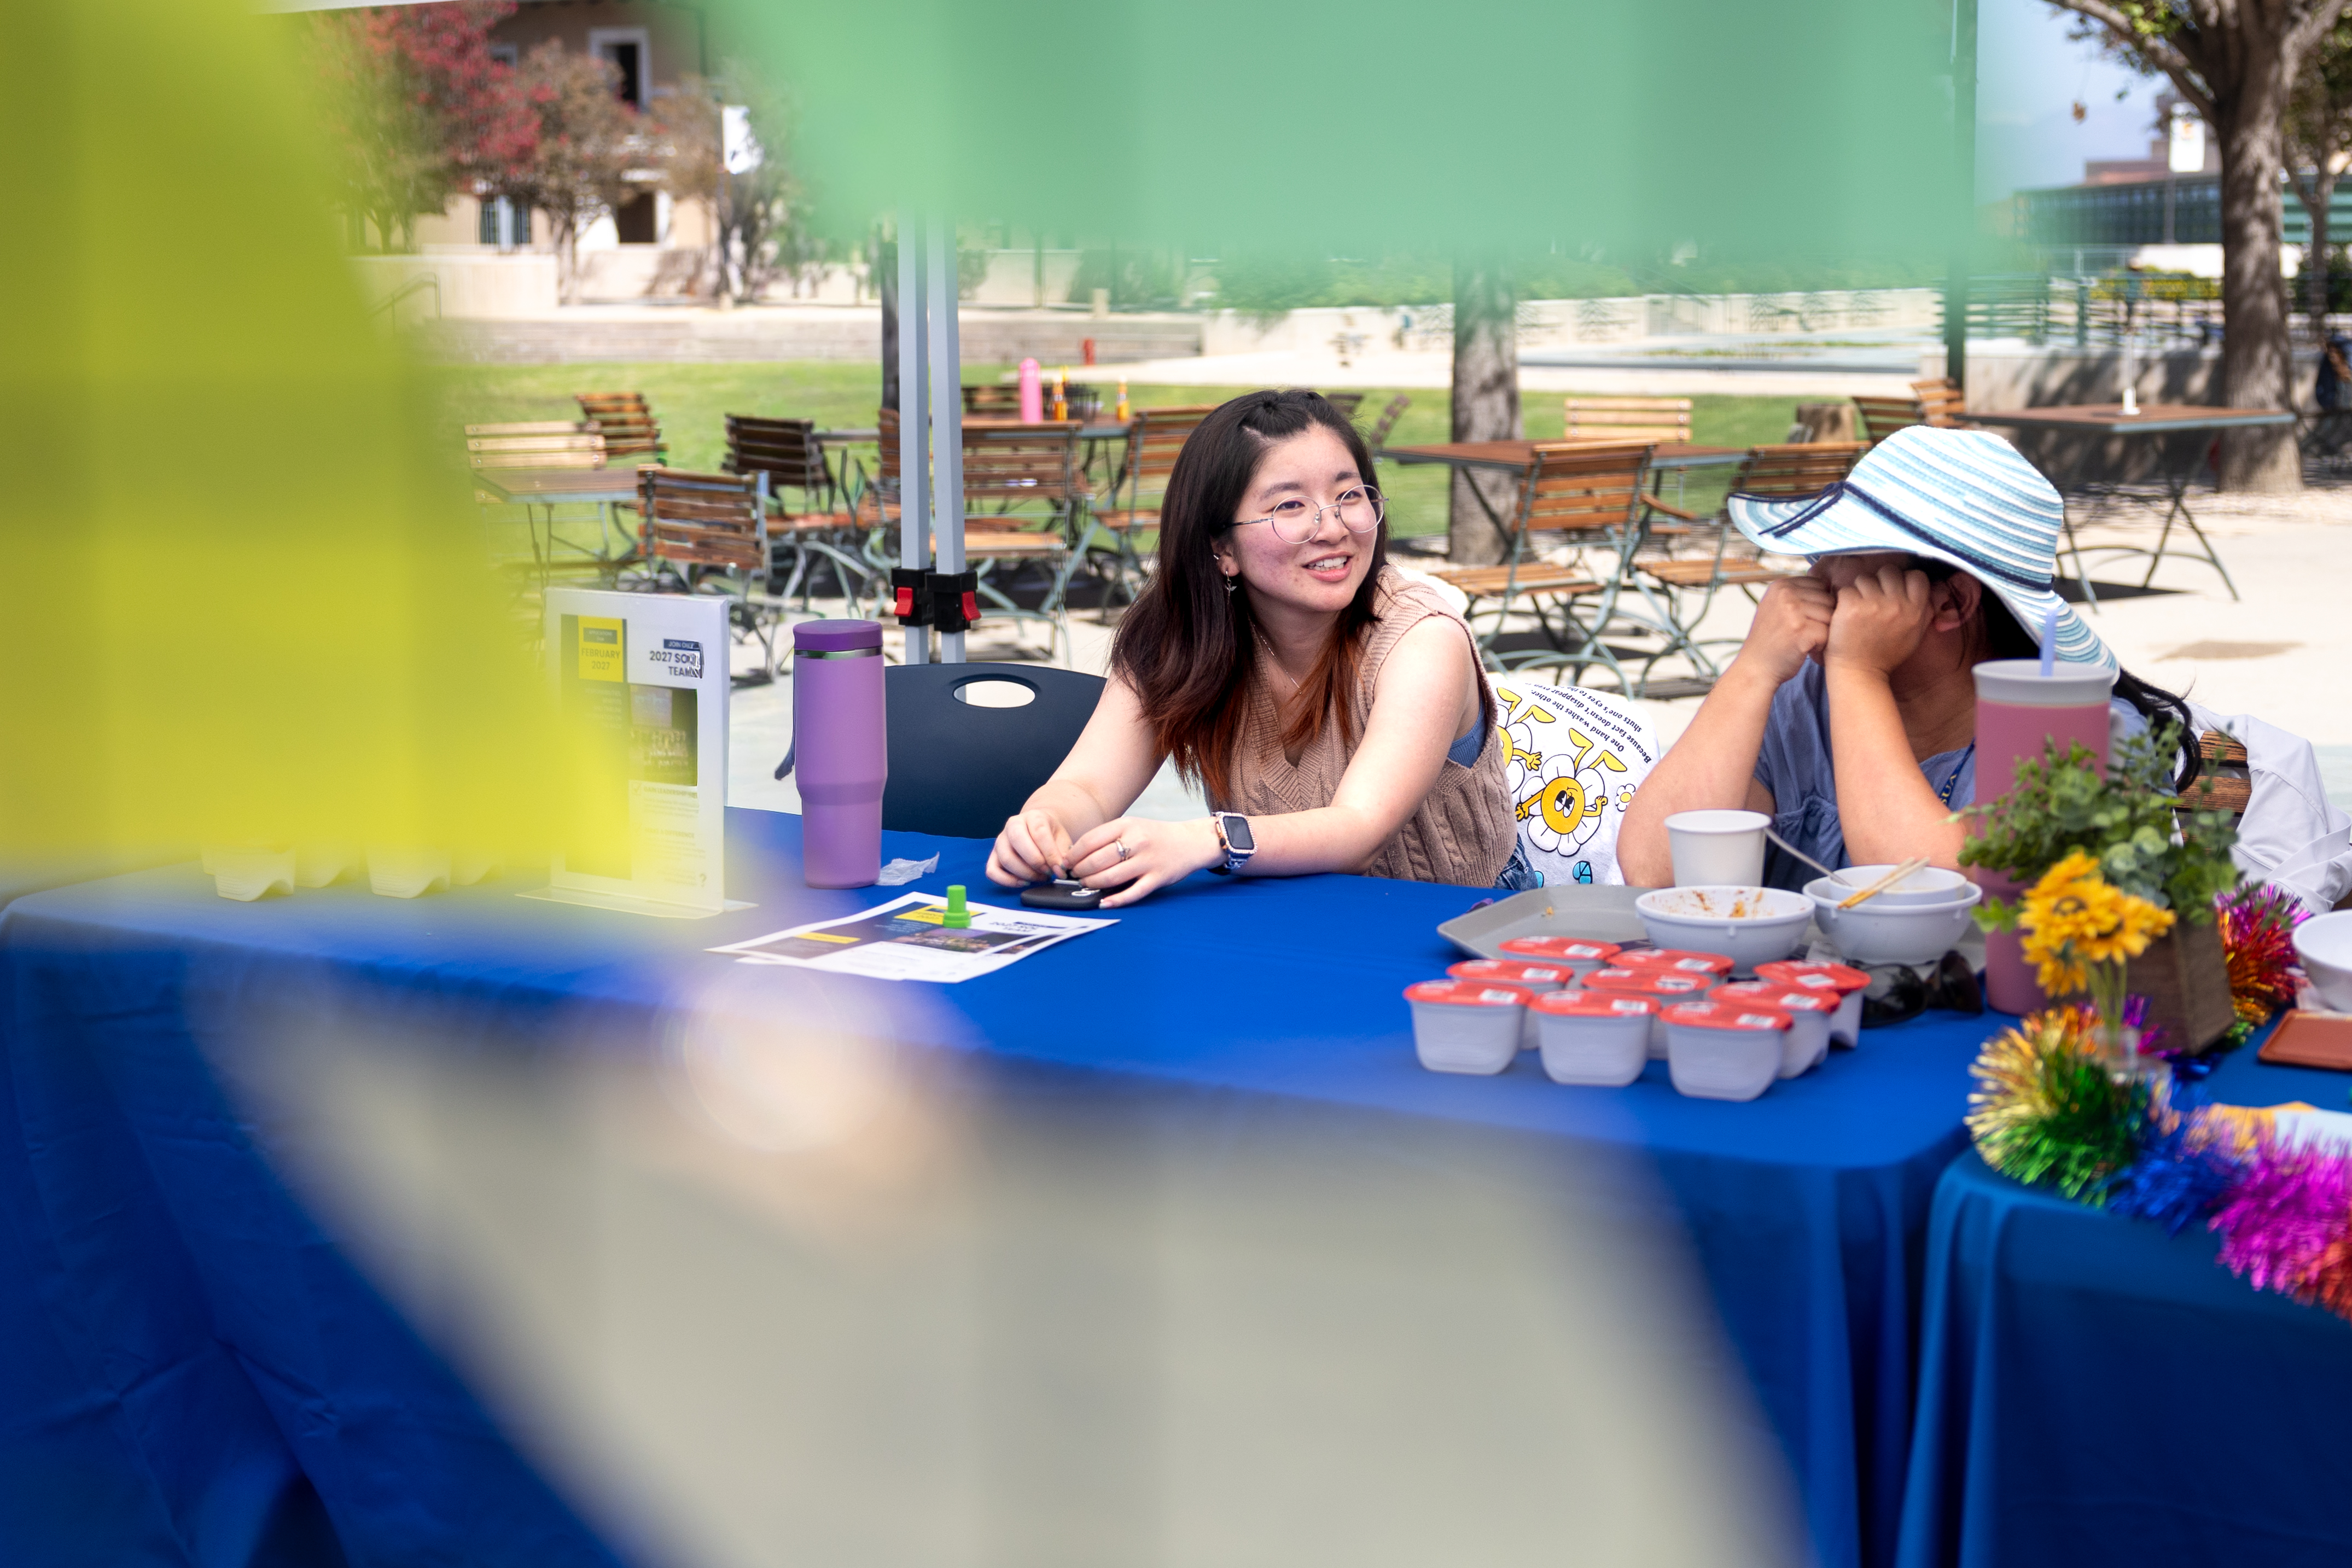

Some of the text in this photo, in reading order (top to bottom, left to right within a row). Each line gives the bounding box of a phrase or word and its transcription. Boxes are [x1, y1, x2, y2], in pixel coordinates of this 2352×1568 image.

[581, 648, 621, 659] FEBRUARY
[649, 650, 672, 662] 2027
[592, 660, 610, 670] 2027
[1551, 689, 1585, 708] disappear
[1587, 695, 1603, 707] eyes
[1585, 707, 1611, 727] doesn't
[1603, 706, 1623, 719] one's
[1531, 690, 1625, 752] One hand washes the other.
[1623, 717, 1642, 733] shuts
[1613, 724, 1627, 738] fact
[1627, 734, 1652, 763] Because
